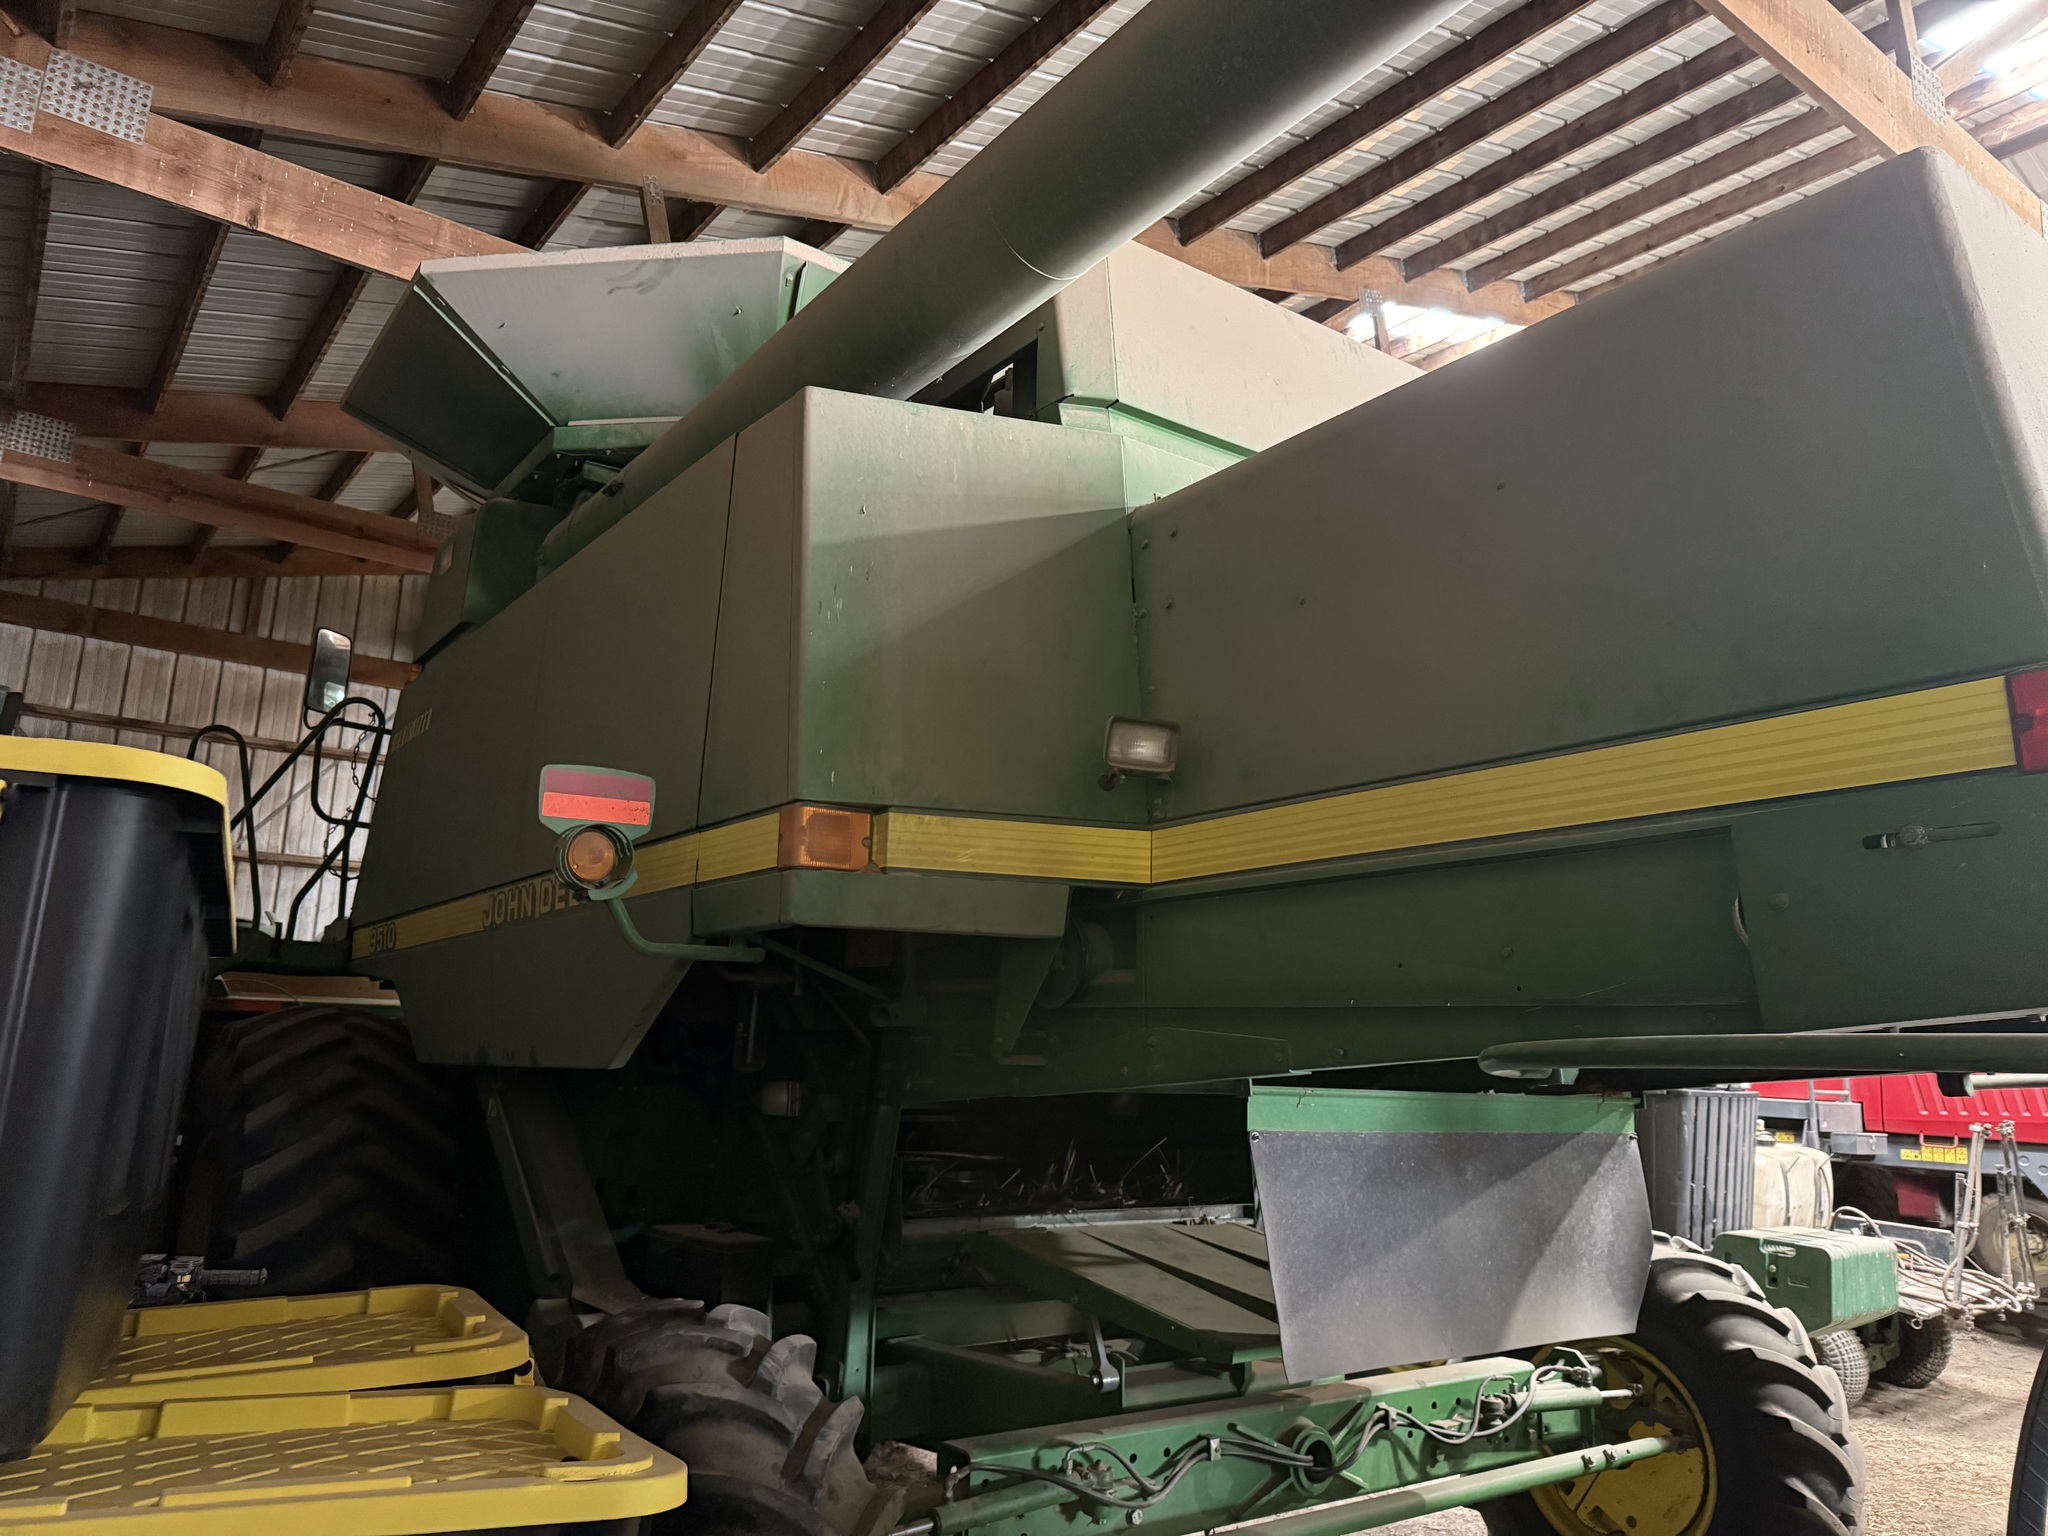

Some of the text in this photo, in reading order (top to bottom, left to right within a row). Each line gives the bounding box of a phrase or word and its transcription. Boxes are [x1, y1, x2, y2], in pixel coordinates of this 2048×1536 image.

[483, 878, 582, 928] JOHN DEE
[369, 921, 397, 954] 9510
